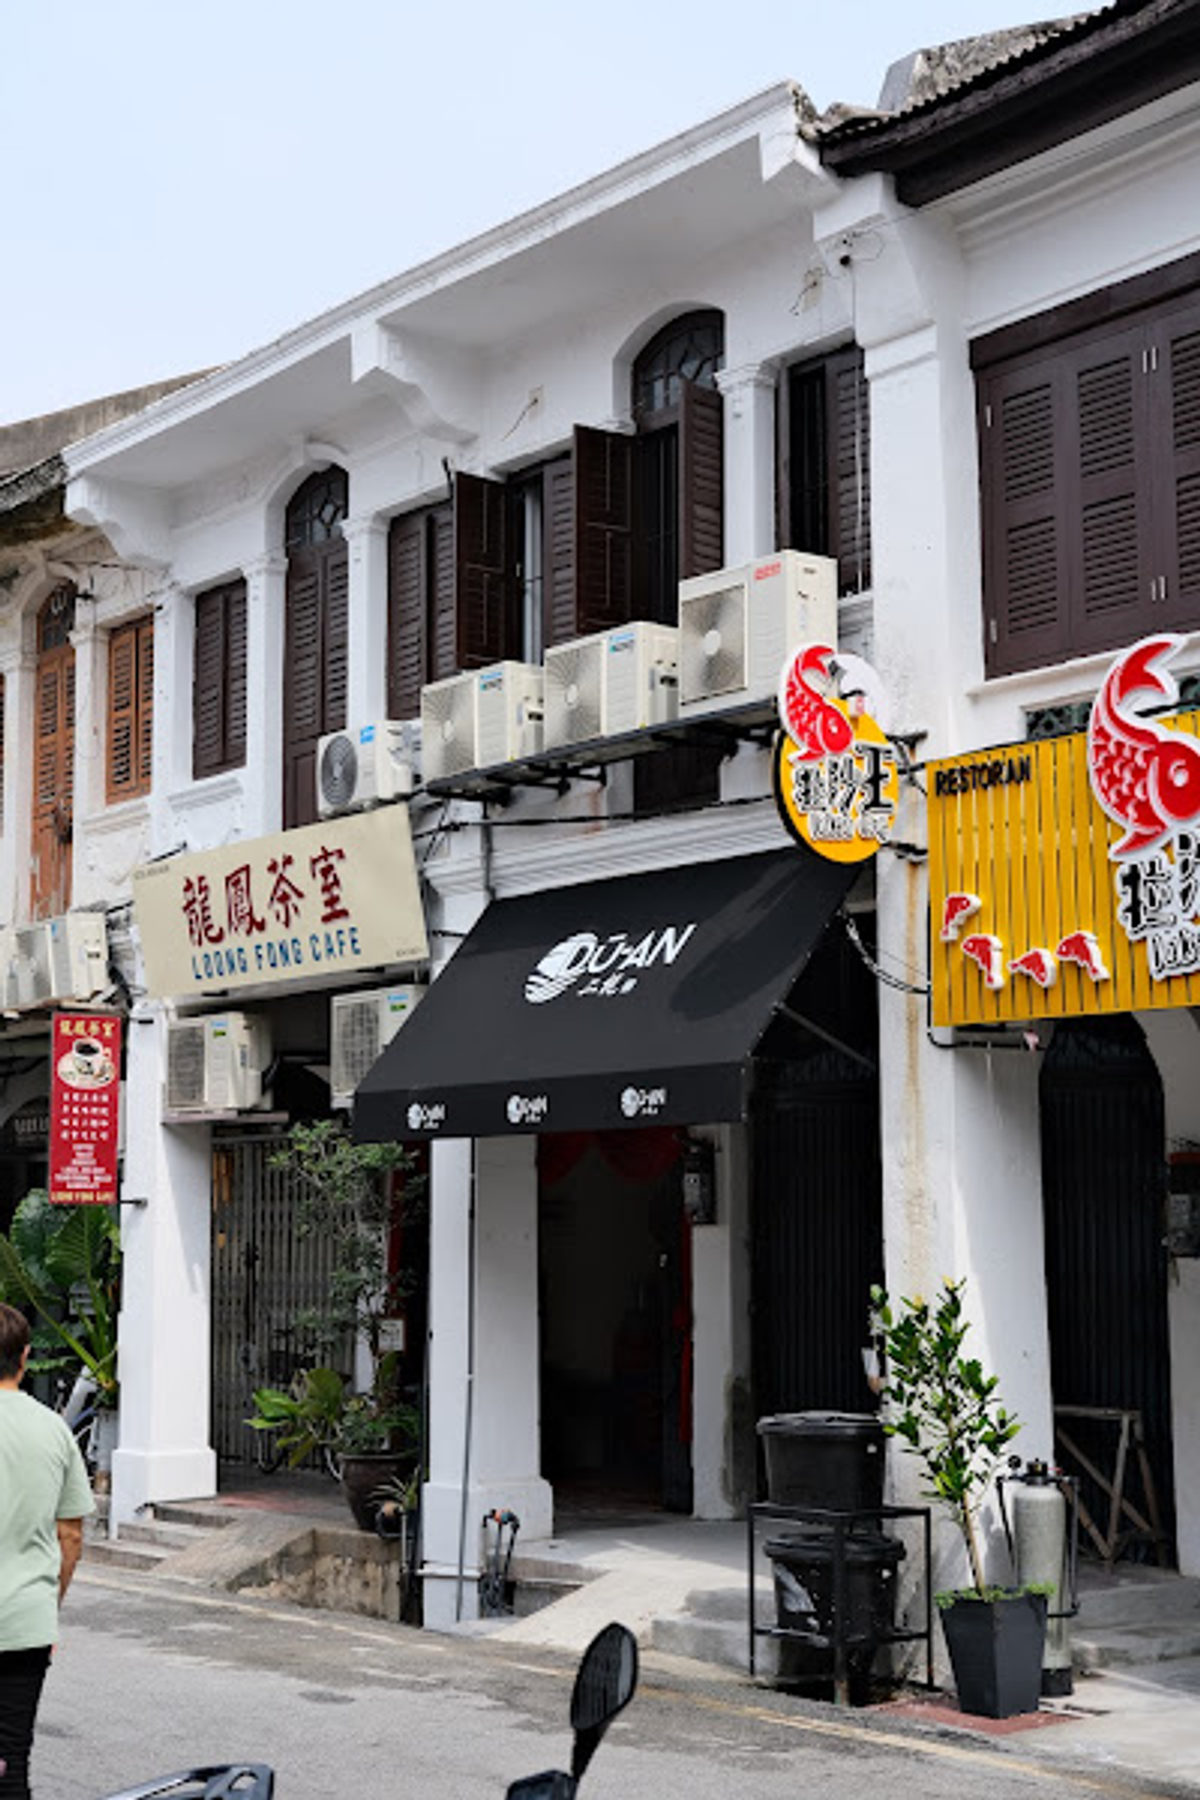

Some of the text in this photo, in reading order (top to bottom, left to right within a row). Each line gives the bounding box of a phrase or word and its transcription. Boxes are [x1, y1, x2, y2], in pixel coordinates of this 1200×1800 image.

[935, 755, 1031, 797] RESTORAN
[182, 845, 350, 947] 龍鳳茶室
[192, 927, 362, 980] LOONG FONG CAFE
